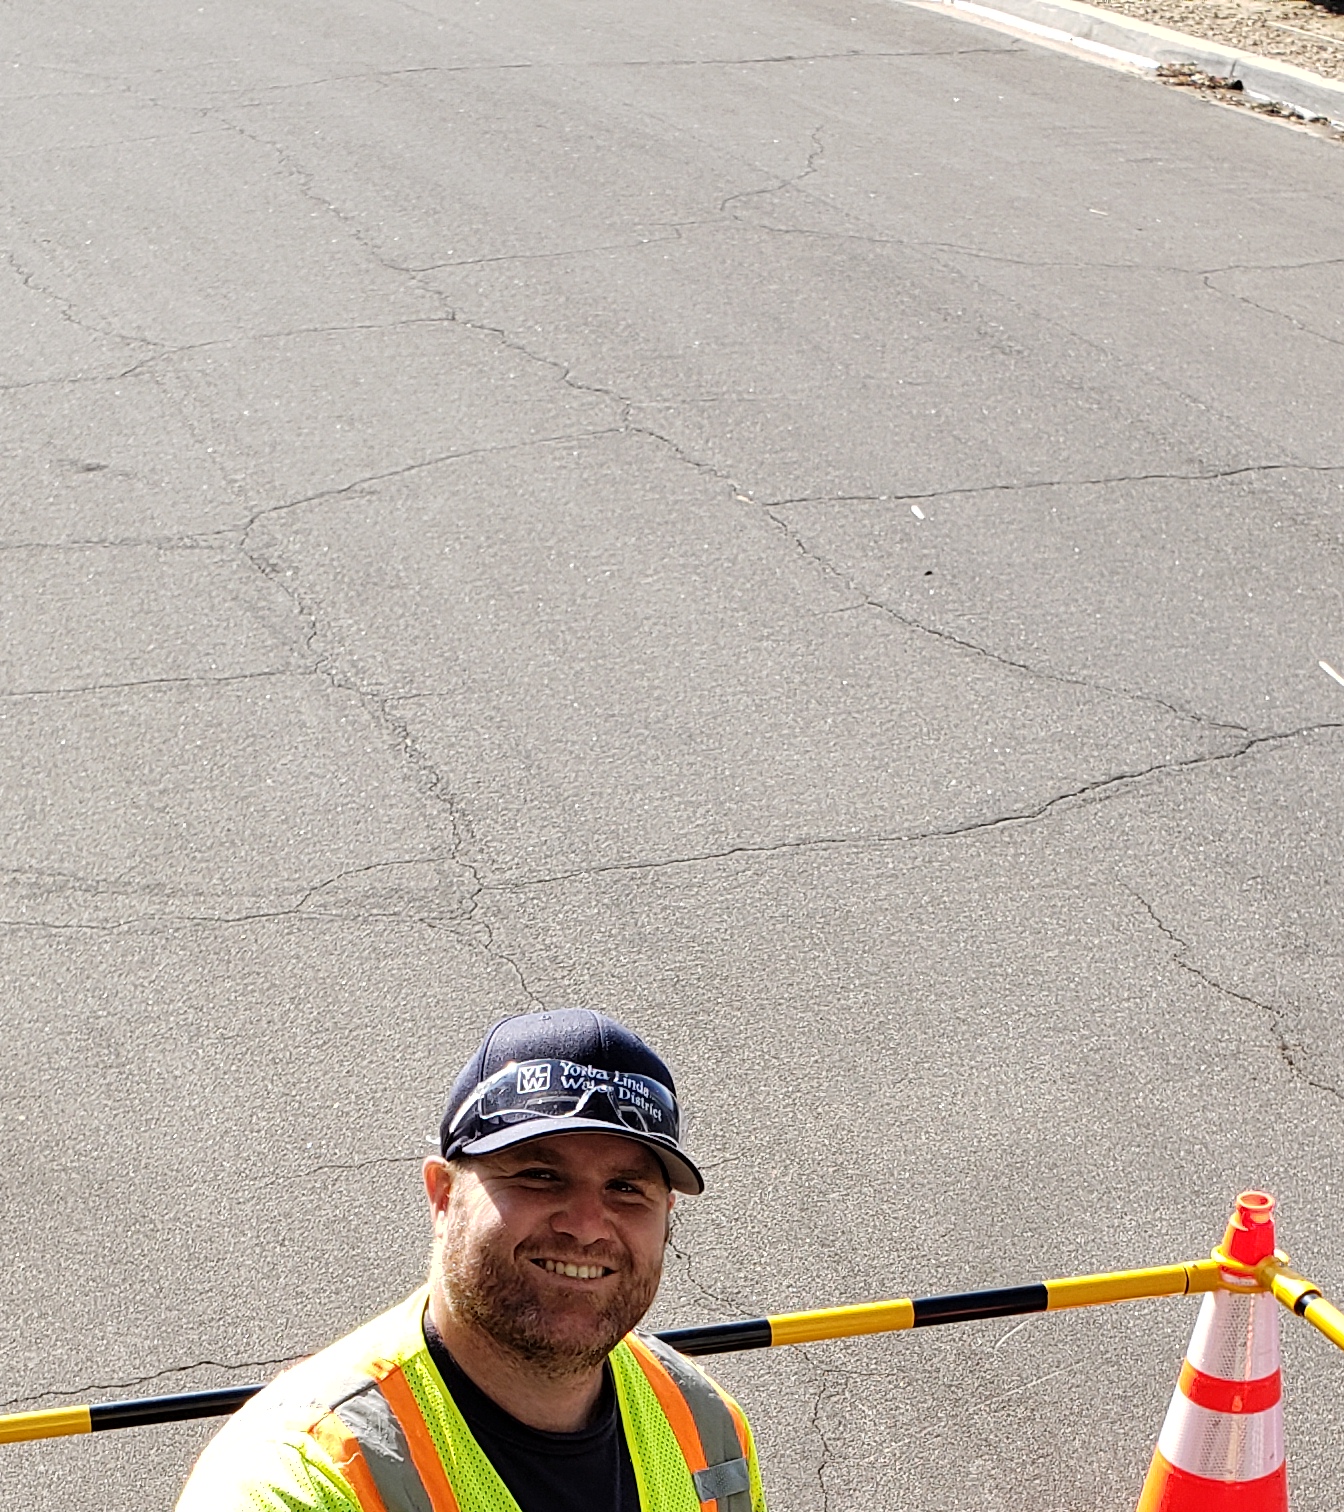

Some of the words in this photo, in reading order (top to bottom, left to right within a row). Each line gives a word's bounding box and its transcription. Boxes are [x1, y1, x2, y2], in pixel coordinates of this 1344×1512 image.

[560, 1060, 608, 1080] Yorba
[613, 1071, 649, 1098] Linda
[618, 1087, 663, 1122] District
